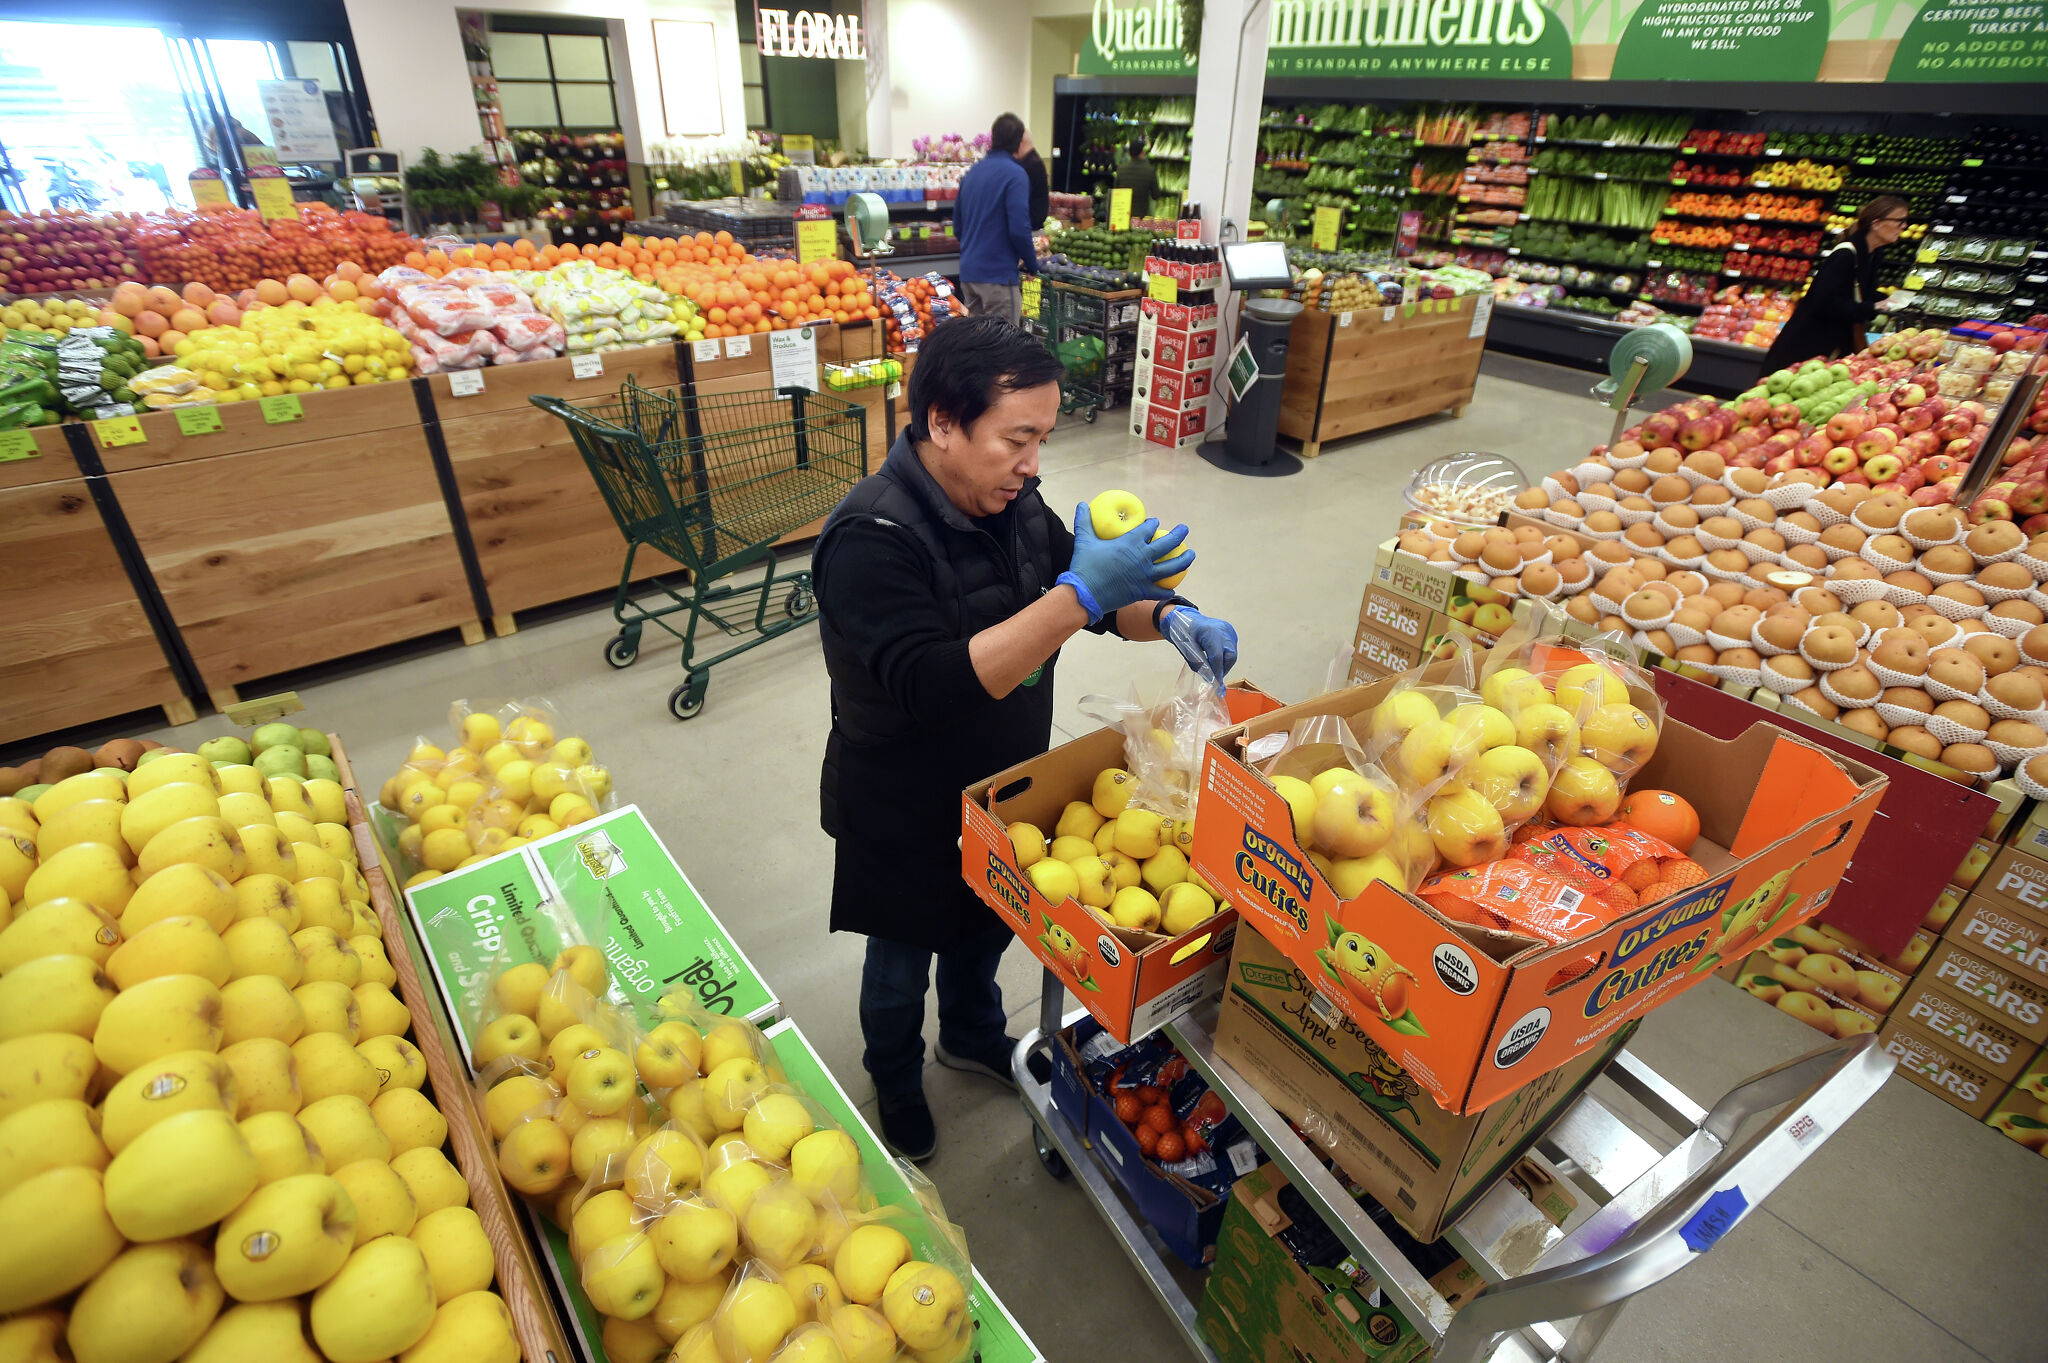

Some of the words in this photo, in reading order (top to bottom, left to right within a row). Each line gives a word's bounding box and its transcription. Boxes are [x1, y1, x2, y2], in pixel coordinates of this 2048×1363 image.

[1642, 13, 1733, 26] HIGH-FRUCTOSE
[1735, 12, 1771, 24] CORN
[1772, 11, 1815, 23] SYRUP
[1657, 1, 1750, 14] HYDROGENATED
[1752, 0, 1780, 11] FATS
[1782, 0, 1802, 10] OR
[1922, 8, 2000, 22] CERTIFIED
[2002, 6, 2045, 19] BEEF,
[760, 8, 867, 60] FLORAL
[1092, 0, 1198, 67] Quali
[1266, 0, 1546, 47] mmitments
[1661, 28, 1674, 38] IN
[1676, 27, 1701, 38] ANY
[1703, 27, 1720, 37] OF
[1722, 26, 1745, 37] THE
[1746, 25, 1782, 37] FOOD
[1968, 21, 2031, 35] TURKEY
[1691, 40, 1708, 49] WE
[1921, 42, 1951, 54] NO
[1952, 40, 2027, 53] ADDED
[1111, 60, 1182, 71] STANDARDS
[1295, 58, 1382, 71] STANDARD
[1388, 58, 1491, 71] ANYWHERE
[1500, 57, 1553, 71] ELSE
[1916, 57, 1946, 69] NO
[772, 342, 796, 350] Produce
[1396, 563, 1425, 580] KOREAN
[1370, 593, 1400, 610] KOREAN
[1392, 572, 1444, 604] PEARS
[1366, 602, 1418, 637] PEARS
[1361, 632, 1391, 650] KOREAN
[1358, 640, 1409, 674] PEARS
[1355, 669, 1379, 682] KORE
[2009, 860, 2048, 886] KORE
[500, 882, 532, 926] Limited
[654, 887, 668, 905] Farms
[986, 867, 1032, 925] Cuties
[1234, 850, 1309, 932] Cuties
[657, 911, 673, 934] Brought
[1236, 887, 1264, 913] MANDARINS
[1273, 914, 1301, 941] CALIFORNIA
[1975, 908, 2039, 942] KOREAN
[466, 894, 512, 963] Crispy
[628, 922, 645, 950] Limited
[712, 937, 729, 961] difference
[1102, 938, 1117, 957] USDA
[1963, 918, 2048, 974] PEAR
[448, 952, 471, 973] and
[605, 936, 656, 993] organic
[723, 967, 735, 981] Taste
[1245, 967, 1286, 985] Organic
[1437, 961, 1471, 990] ORGANIC
[1444, 950, 1470, 977] USDA
[1582, 927, 1712, 1020] Cuties
[1838, 947, 1881, 974] Evergreen
[1879, 967, 1902, 983] Farm
[1947, 951, 2009, 985] KOREAN
[1151, 992, 1176, 1008] ORGANIC
[1815, 985, 1856, 1012] Evergreen
[1853, 1006, 1877, 1022] Farm
[1935, 961, 2044, 1025] PEARS
[1574, 1011, 1625, 1047] MANDARINS
[1642, 971, 1686, 1002] CALIFORNIA
[1920, 991, 1978, 1027] KOREAN
[1281, 1001, 1337, 1050] Apple
[1509, 1017, 1541, 1042] USDA
[1908, 1001, 2013, 1065] PEARS
[1500, 1032, 1540, 1060] ORGANIC
[1893, 1031, 1949, 1066] KOREAN
[1884, 1040, 1981, 1102] PEARS
[1788, 1114, 1815, 1139] SPG
[1693, 1206, 1732, 1244] WASH
